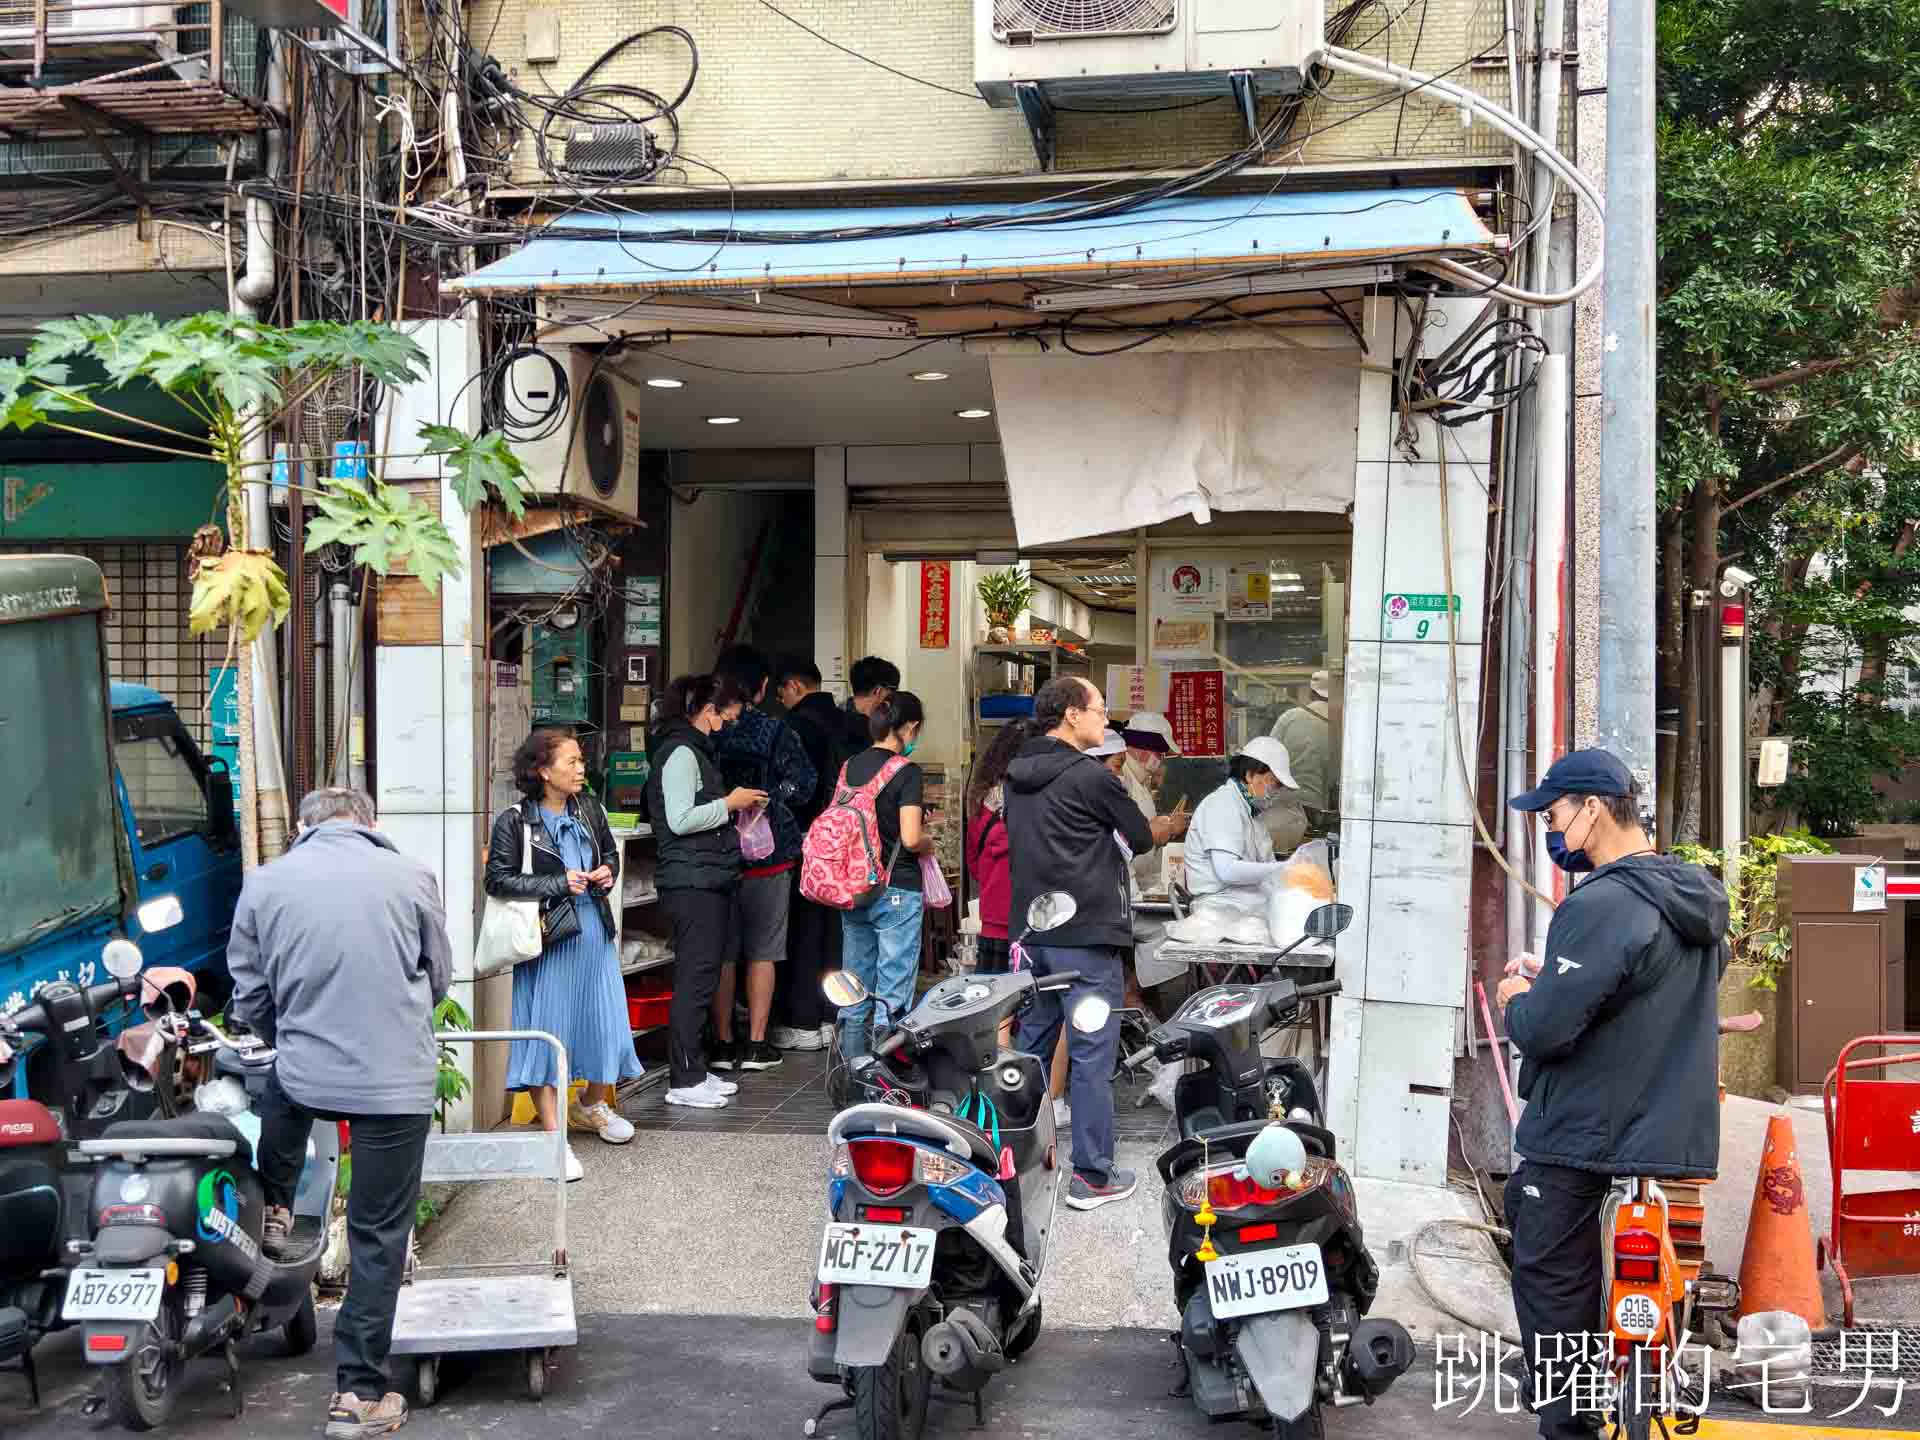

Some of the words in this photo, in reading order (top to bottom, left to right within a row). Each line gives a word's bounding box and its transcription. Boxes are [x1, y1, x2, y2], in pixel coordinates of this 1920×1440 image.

[1416, 619, 1430, 639] 9
[70, 1283, 157, 1306] AB76977
[1624, 1298, 1650, 1313] 016
